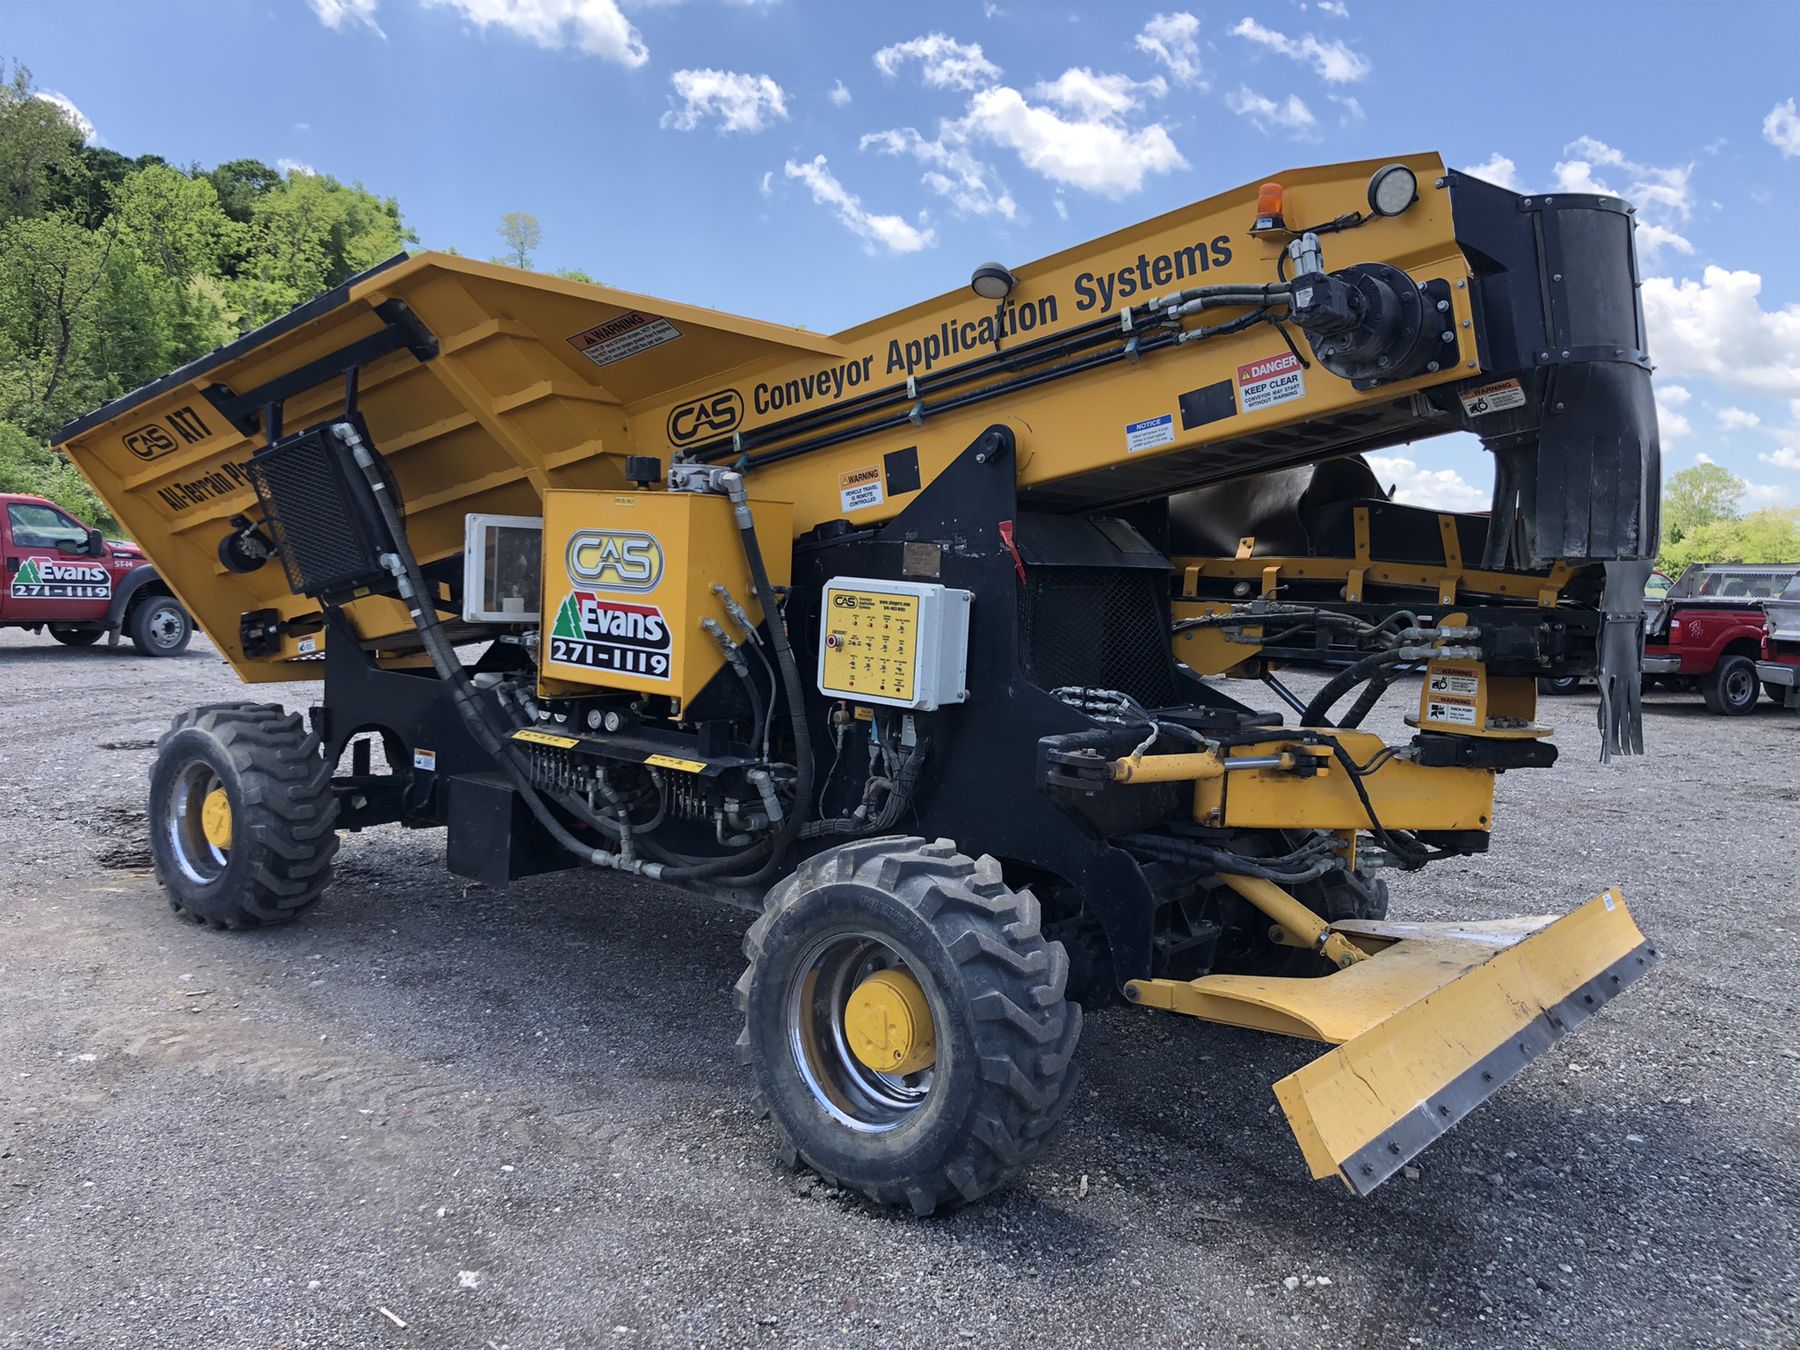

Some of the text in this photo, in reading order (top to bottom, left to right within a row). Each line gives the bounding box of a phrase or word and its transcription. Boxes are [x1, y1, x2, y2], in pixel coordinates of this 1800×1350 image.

[591, 313, 644, 341] WARNING
[753, 234, 1233, 415] Conveyor Application Systems
[1251, 354, 1298, 378] DANGER
[1244, 374, 1299, 396] KEEP CLEAR
[1245, 383, 1300, 403] CONVEYOR MAY START
[1471, 381, 1511, 396] WARNING
[1248, 389, 1298, 407] WITHOUT WARNING
[672, 395, 736, 440] CAS
[1136, 418, 1161, 430] NOTICE
[127, 406, 213, 457] CAS AT7
[848, 469, 879, 483] WARNING
[157, 471, 236, 511] All-Terrain
[845, 484, 878, 497] VEHICLE TRAVEL
[856, 491, 873, 499] REMOTE
[849, 496, 877, 507] CONTROLLED
[572, 536, 652, 581] CAS
[40, 562, 104, 581] Evans
[15, 585, 107, 597] 271-1119
[835, 596, 856, 607] CAS
[582, 599, 663, 641] Evans
[553, 641, 667, 675] 271-1119
[1441, 668, 1472, 676] WARNING
[1440, 696, 1471, 705] WARNING
